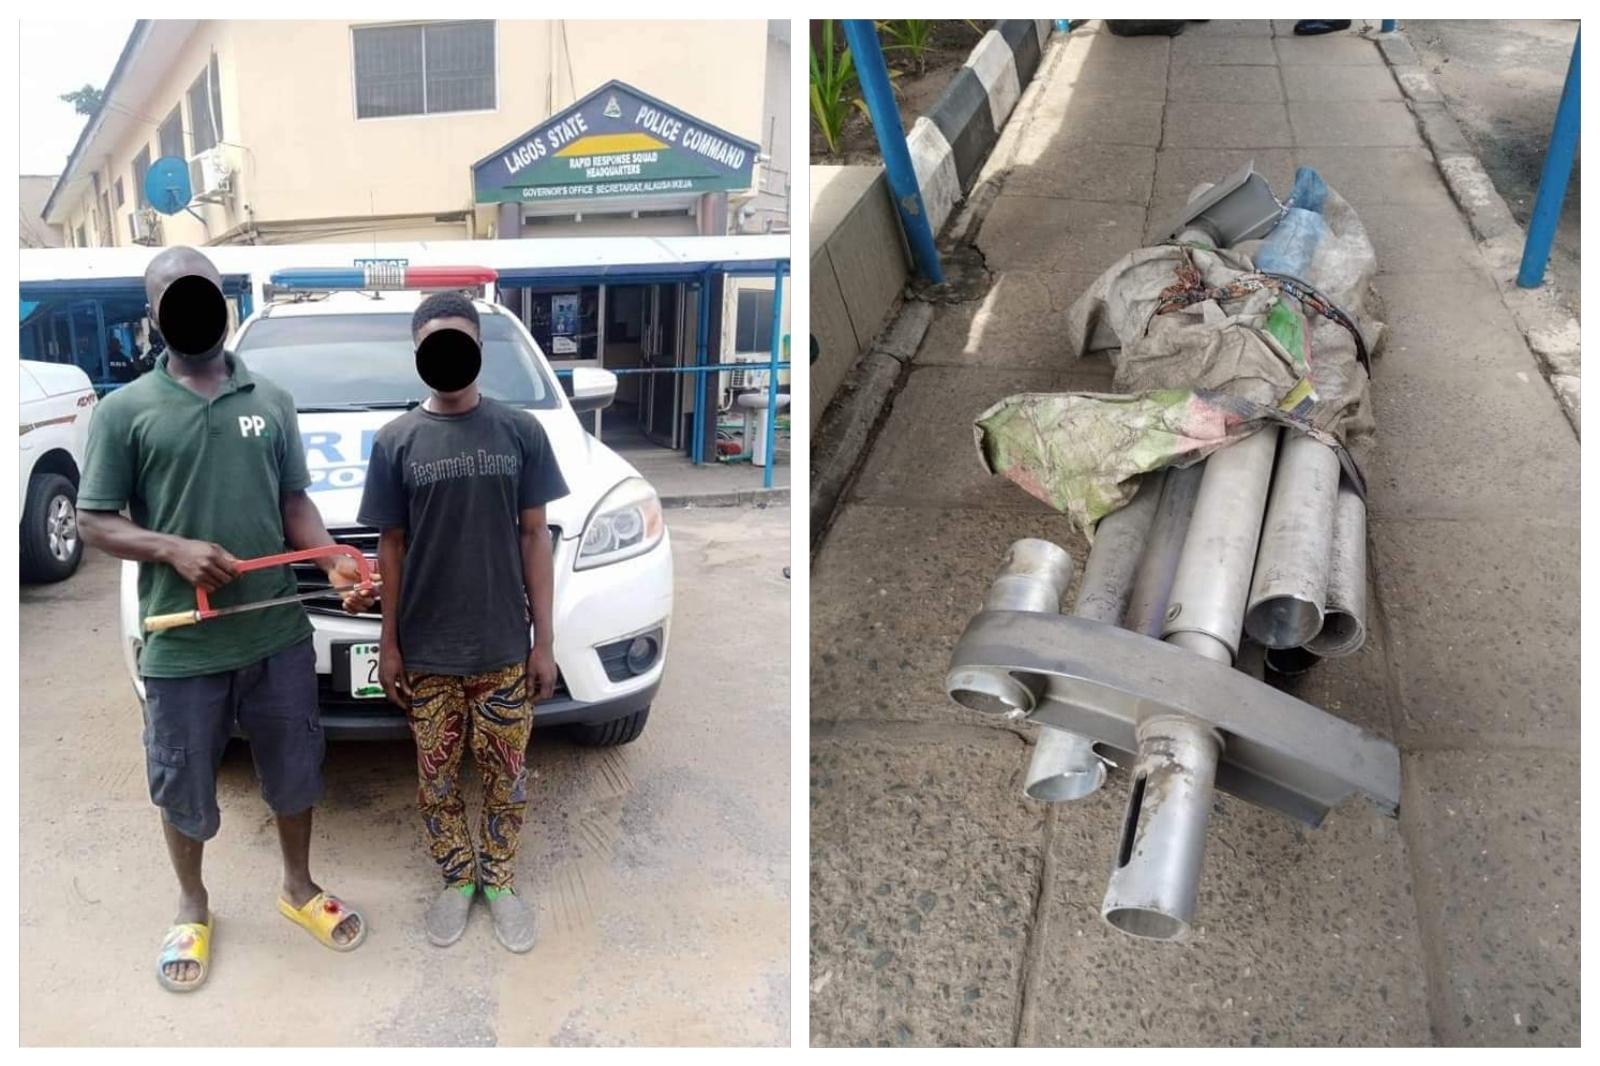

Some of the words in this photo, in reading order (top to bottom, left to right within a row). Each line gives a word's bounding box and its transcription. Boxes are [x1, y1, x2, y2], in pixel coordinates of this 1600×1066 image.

[503, 137, 547, 174] LAGOS
[548, 112, 589, 148] STATE
[635, 105, 682, 142] POLICE
[682, 127, 746, 170] COMMAND
[569, 157, 592, 169] RAPID
[592, 153, 631, 167] RESPONSE
[632, 151, 659, 163] SQUAD
[586, 164, 641, 178] HEADQUARTERS
[522, 187, 567, 198] GOVERNOR'S
[568, 185, 594, 195] OFFICE
[477, 449, 517, 477] Dance
